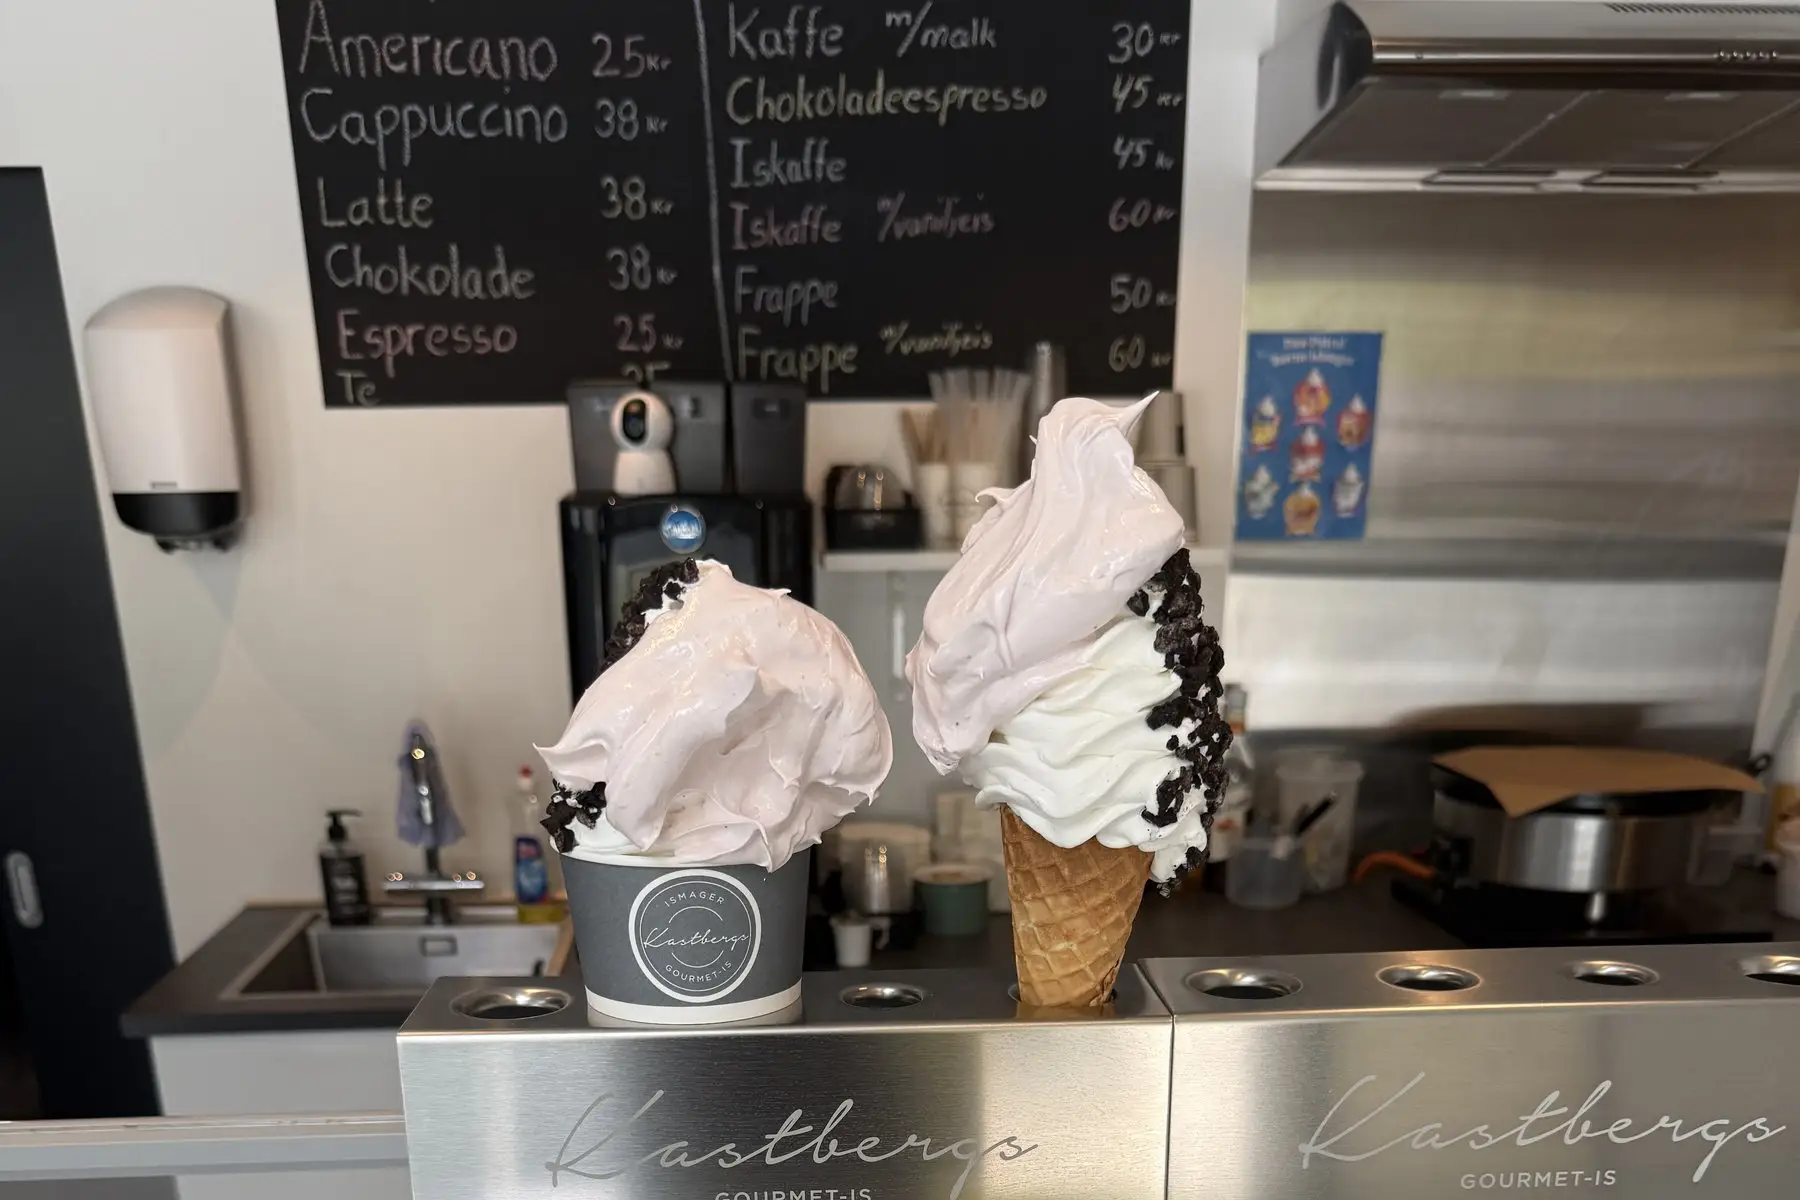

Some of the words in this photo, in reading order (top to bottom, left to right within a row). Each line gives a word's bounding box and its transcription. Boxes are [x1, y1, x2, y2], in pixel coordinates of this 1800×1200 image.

[299, 0, 558, 81] Americano
[592, 33, 645, 78] 25
[727, 1, 844, 60] Kaffe
[1108, 22, 1154, 64] 30
[726, 68, 1048, 126] Chokoladeespresso
[1112, 73, 1154, 113] 45
[300, 86, 568, 170] Cappuccino
[594, 98, 640, 141] 38
[728, 137, 847, 188] Iskaffe
[1113, 135, 1154, 170] 45
[317, 176, 435, 229] Latte
[600, 176, 647, 220] 38
[729, 202, 843, 250] Iskaffe
[1108, 197, 1151, 232] 60
[325, 243, 537, 300] Chokolade
[607, 244, 652, 291] 38
[734, 264, 840, 328] Frappe
[1110, 274, 1152, 315] 50
[337, 309, 518, 379] Espresso
[614, 313, 657, 353] 25
[736, 324, 859, 394] Frappe
[1108, 334, 1146, 372] 60
[336, 370, 382, 405] Te
[664, 891, 725, 908] ISMAGER
[644, 927, 750, 951] Kastbergs
[664, 960, 732, 983] GOURMET-IS
[545, 1089, 1039, 1200] Kastbergs
[1299, 1071, 1788, 1183] Kastbergs
[1460, 1169, 1618, 1190] GOURMET-IS
